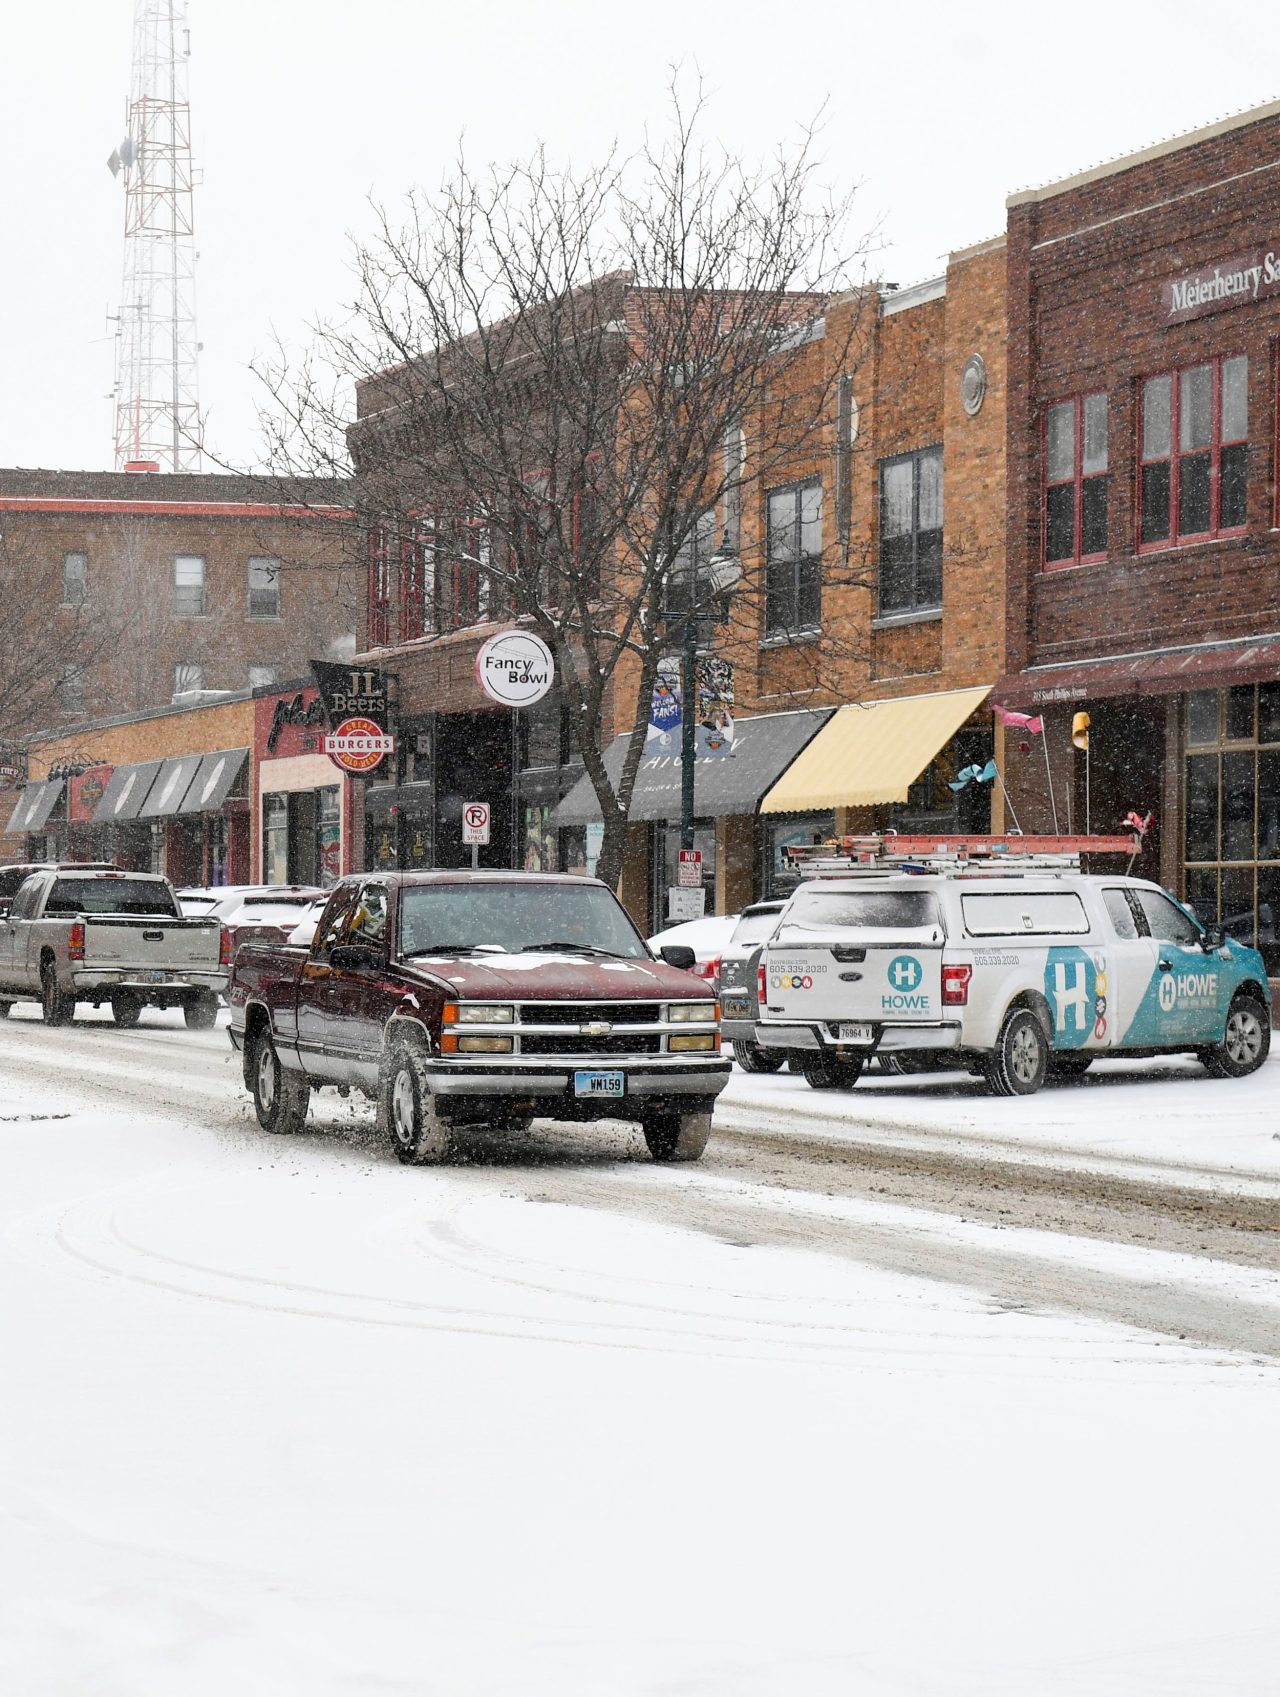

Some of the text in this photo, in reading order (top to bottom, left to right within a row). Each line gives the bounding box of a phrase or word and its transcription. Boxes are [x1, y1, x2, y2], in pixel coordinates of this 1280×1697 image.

[1170, 266, 1263, 313] Meierhenry
[485, 656, 533, 672] Fancy
[348, 672, 382, 697] JL
[508, 671, 548, 684] Bowl
[331, 693, 385, 712] Beers
[653, 704, 678, 722] FANS!
[346, 721, 373, 731] GREAT
[328, 739, 391, 749] BURGERS
[684, 852, 697, 862] NO
[974, 955, 1020, 966] 605.339.2020
[769, 965, 828, 974] 605.339.2020
[893, 962, 917, 986] H
[1177, 973, 1218, 997] HOWE
[1052, 962, 1090, 1031] H
[841, 1028, 871, 1039] 76964 V
